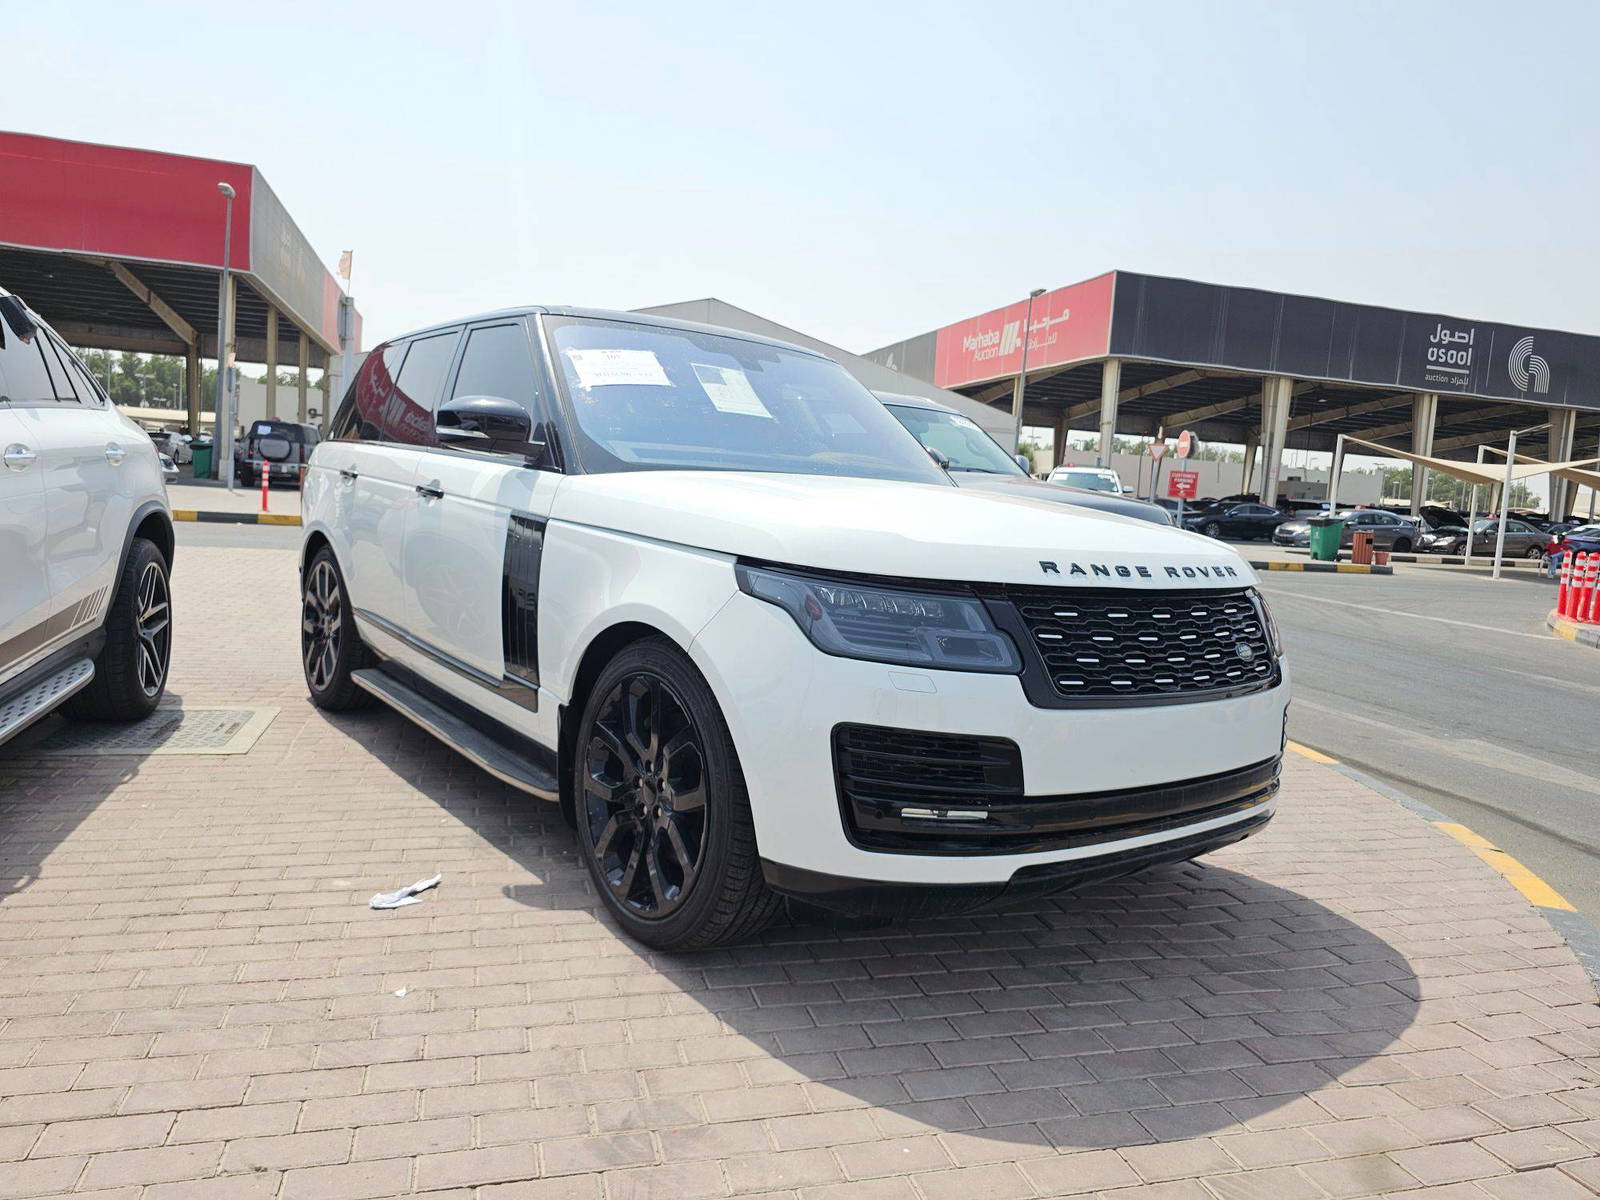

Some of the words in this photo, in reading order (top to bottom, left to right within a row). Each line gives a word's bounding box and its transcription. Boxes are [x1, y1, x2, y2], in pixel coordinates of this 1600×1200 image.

[962, 329, 1000, 352] Marhaba
[972, 346, 998, 361] Auction
[1427, 347, 1472, 366] asool
[1425, 374, 1448, 383] auction
[1039, 560, 1152, 578] RANGE
[1163, 565, 1238, 578] ROVER
